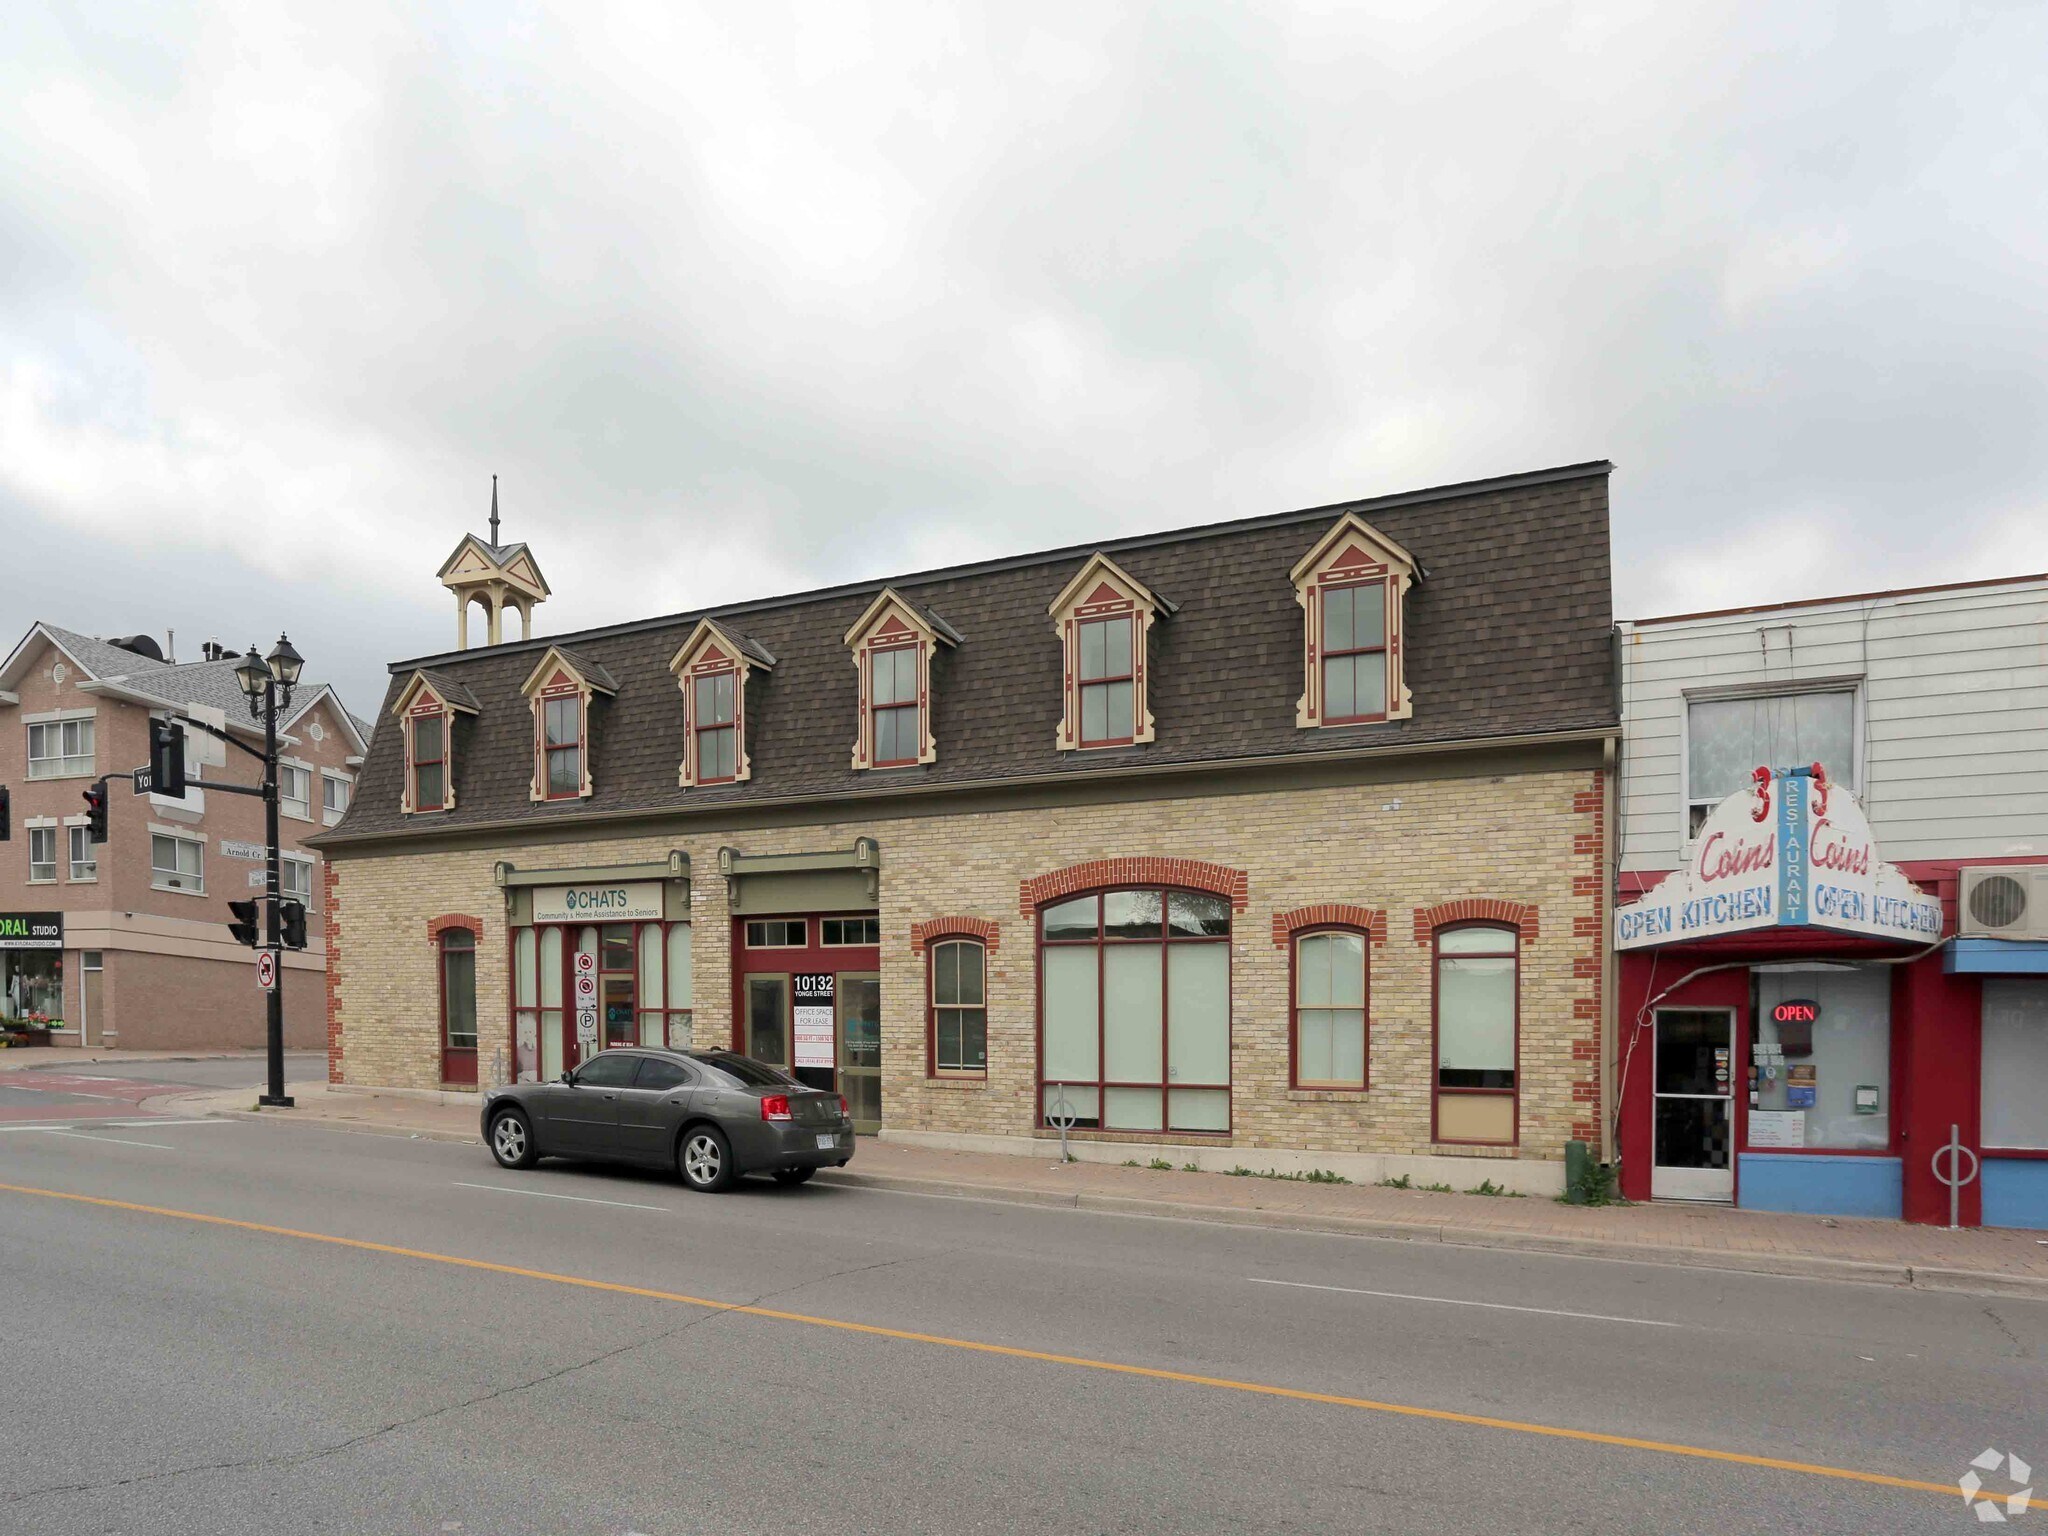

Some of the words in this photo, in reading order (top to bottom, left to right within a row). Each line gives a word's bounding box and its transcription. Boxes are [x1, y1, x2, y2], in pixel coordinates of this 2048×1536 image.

[1752, 766, 1771, 822] 3
[226, 848, 250, 858] Arnold
[252, 851, 261, 859] Cr
[1701, 832, 1775, 882] Coins
[1785, 781, 1801, 920] RESTAURANT
[1810, 818, 1869, 876] Coins
[537, 912, 568, 920] Community
[594, 909, 626, 918] Assistance
[627, 909, 634, 917] to
[635, 908, 658, 917] Seniors
[578, 889, 627, 909] CHATS
[1620, 905, 1672, 940] OPEN
[1681, 885, 1772, 930] KITCHEN
[1815, 884, 1865, 921] OPEN
[1873, 894, 1942, 934] KITCHEN
[32, 925, 58, 936] STUDIO
[795, 975, 833, 991] 10132
[1774, 1005, 1814, 1021] OPEN
